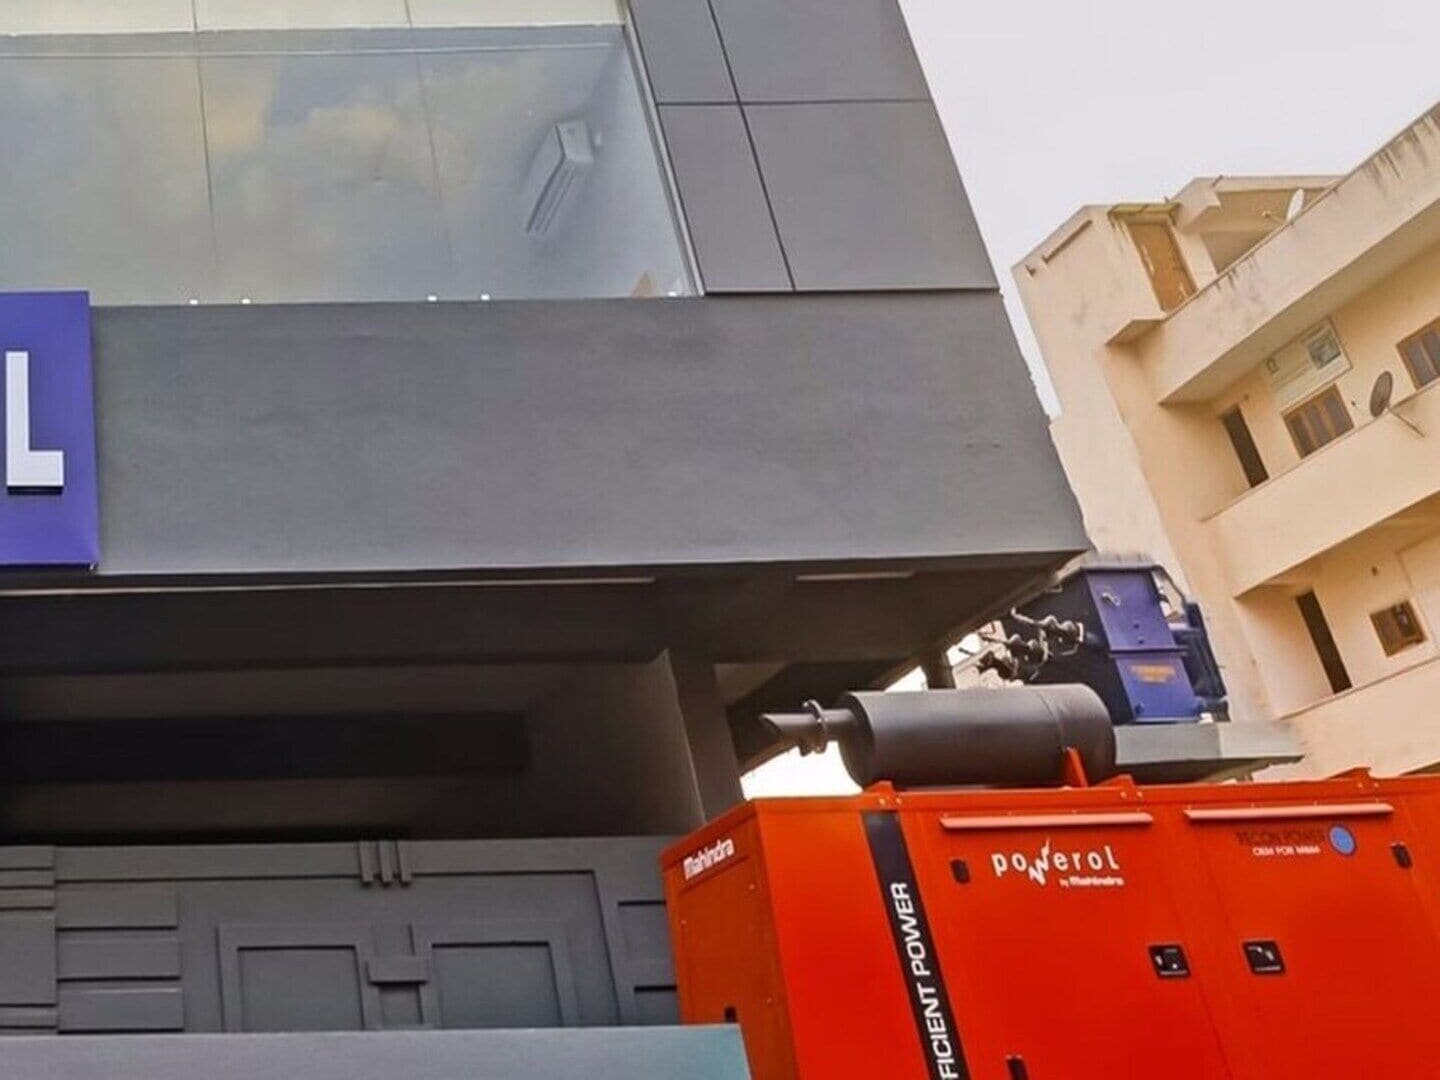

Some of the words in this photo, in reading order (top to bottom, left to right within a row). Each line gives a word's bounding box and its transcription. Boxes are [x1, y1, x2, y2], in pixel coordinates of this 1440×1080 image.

[683, 838, 735, 881] Mahindra
[991, 836, 1119, 886] powerol
[890, 882, 931, 976] POWER
